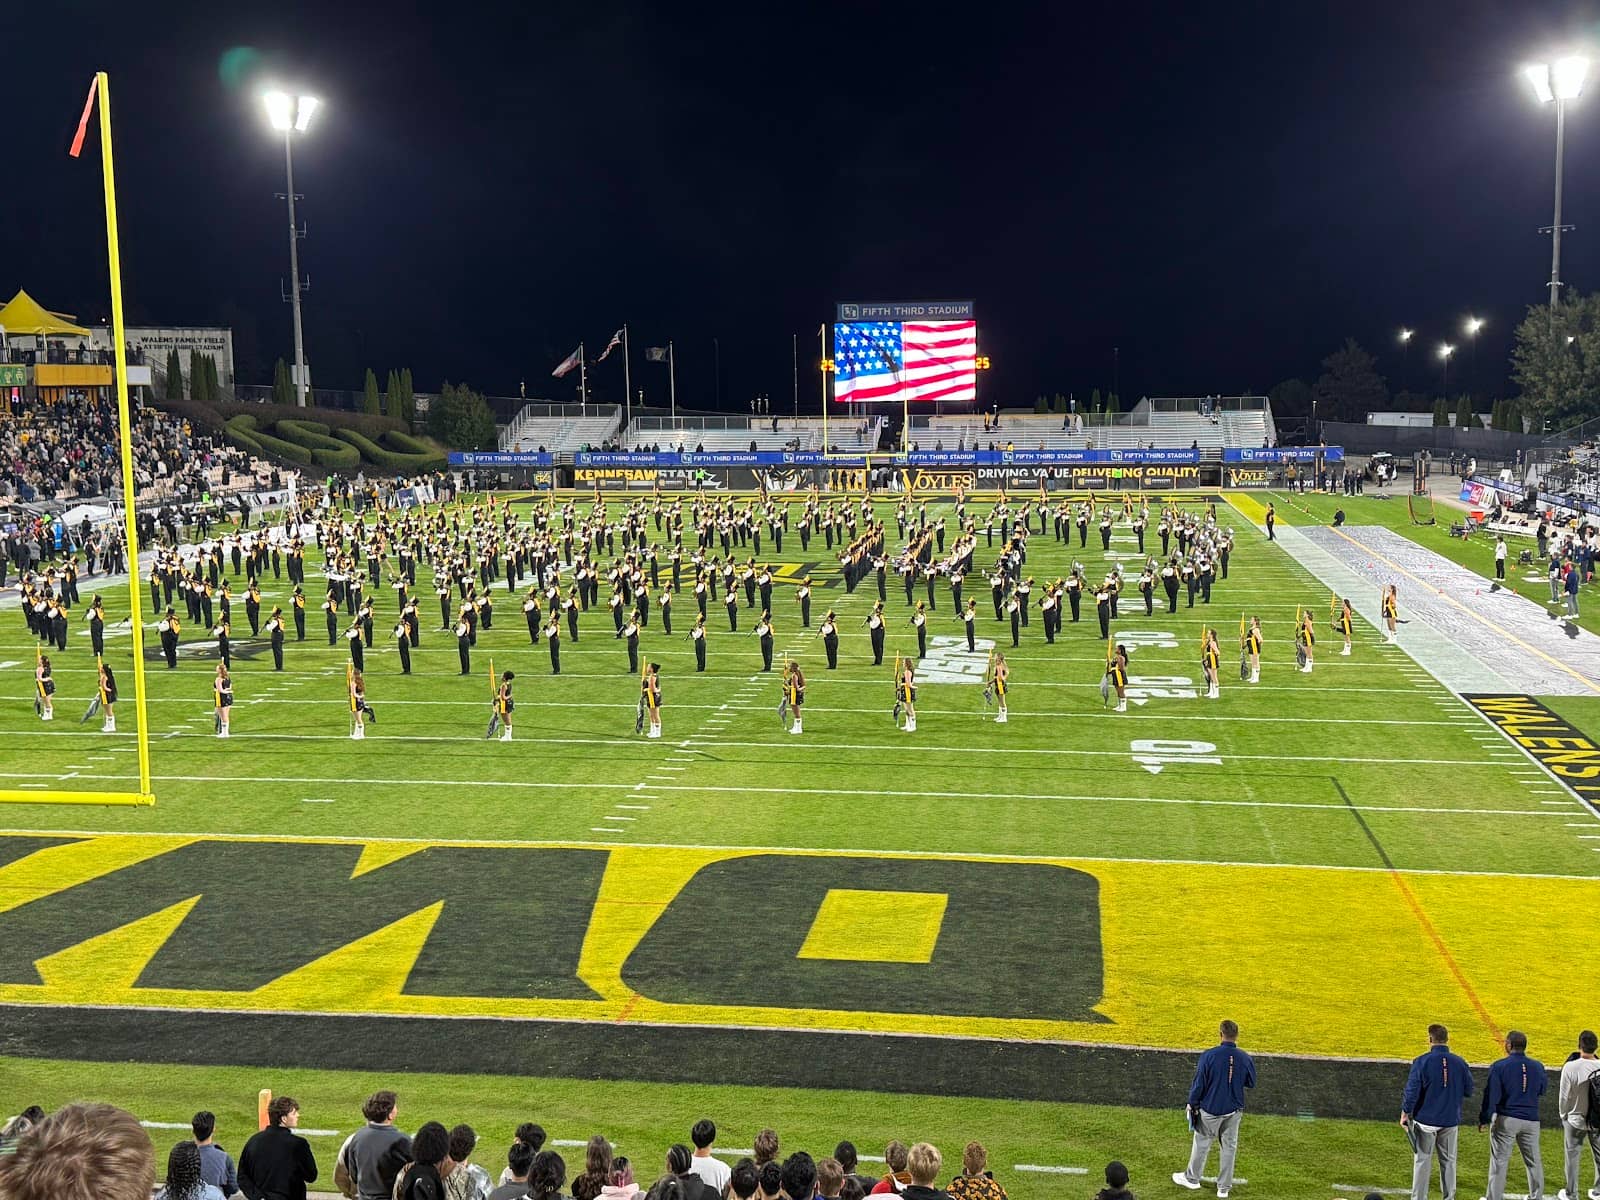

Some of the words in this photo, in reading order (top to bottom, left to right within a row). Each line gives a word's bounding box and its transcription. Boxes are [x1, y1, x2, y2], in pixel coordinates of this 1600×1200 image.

[862, 307, 891, 316] FIFTH
[894, 306, 924, 316] THIRD
[927, 305, 969, 315] STADIUM
[975, 357, 990, 370] 25
[574, 469, 658, 481] KENNESAW
[901, 468, 972, 490] VOYLES
[978, 468, 1029, 478] DRIVING
[1031, 468, 1072, 478] VAUE.
[1146, 467, 1200, 477] QUALITY.
[1470, 697, 1600, 778] WALENS
[1130, 739, 1224, 765] 10
